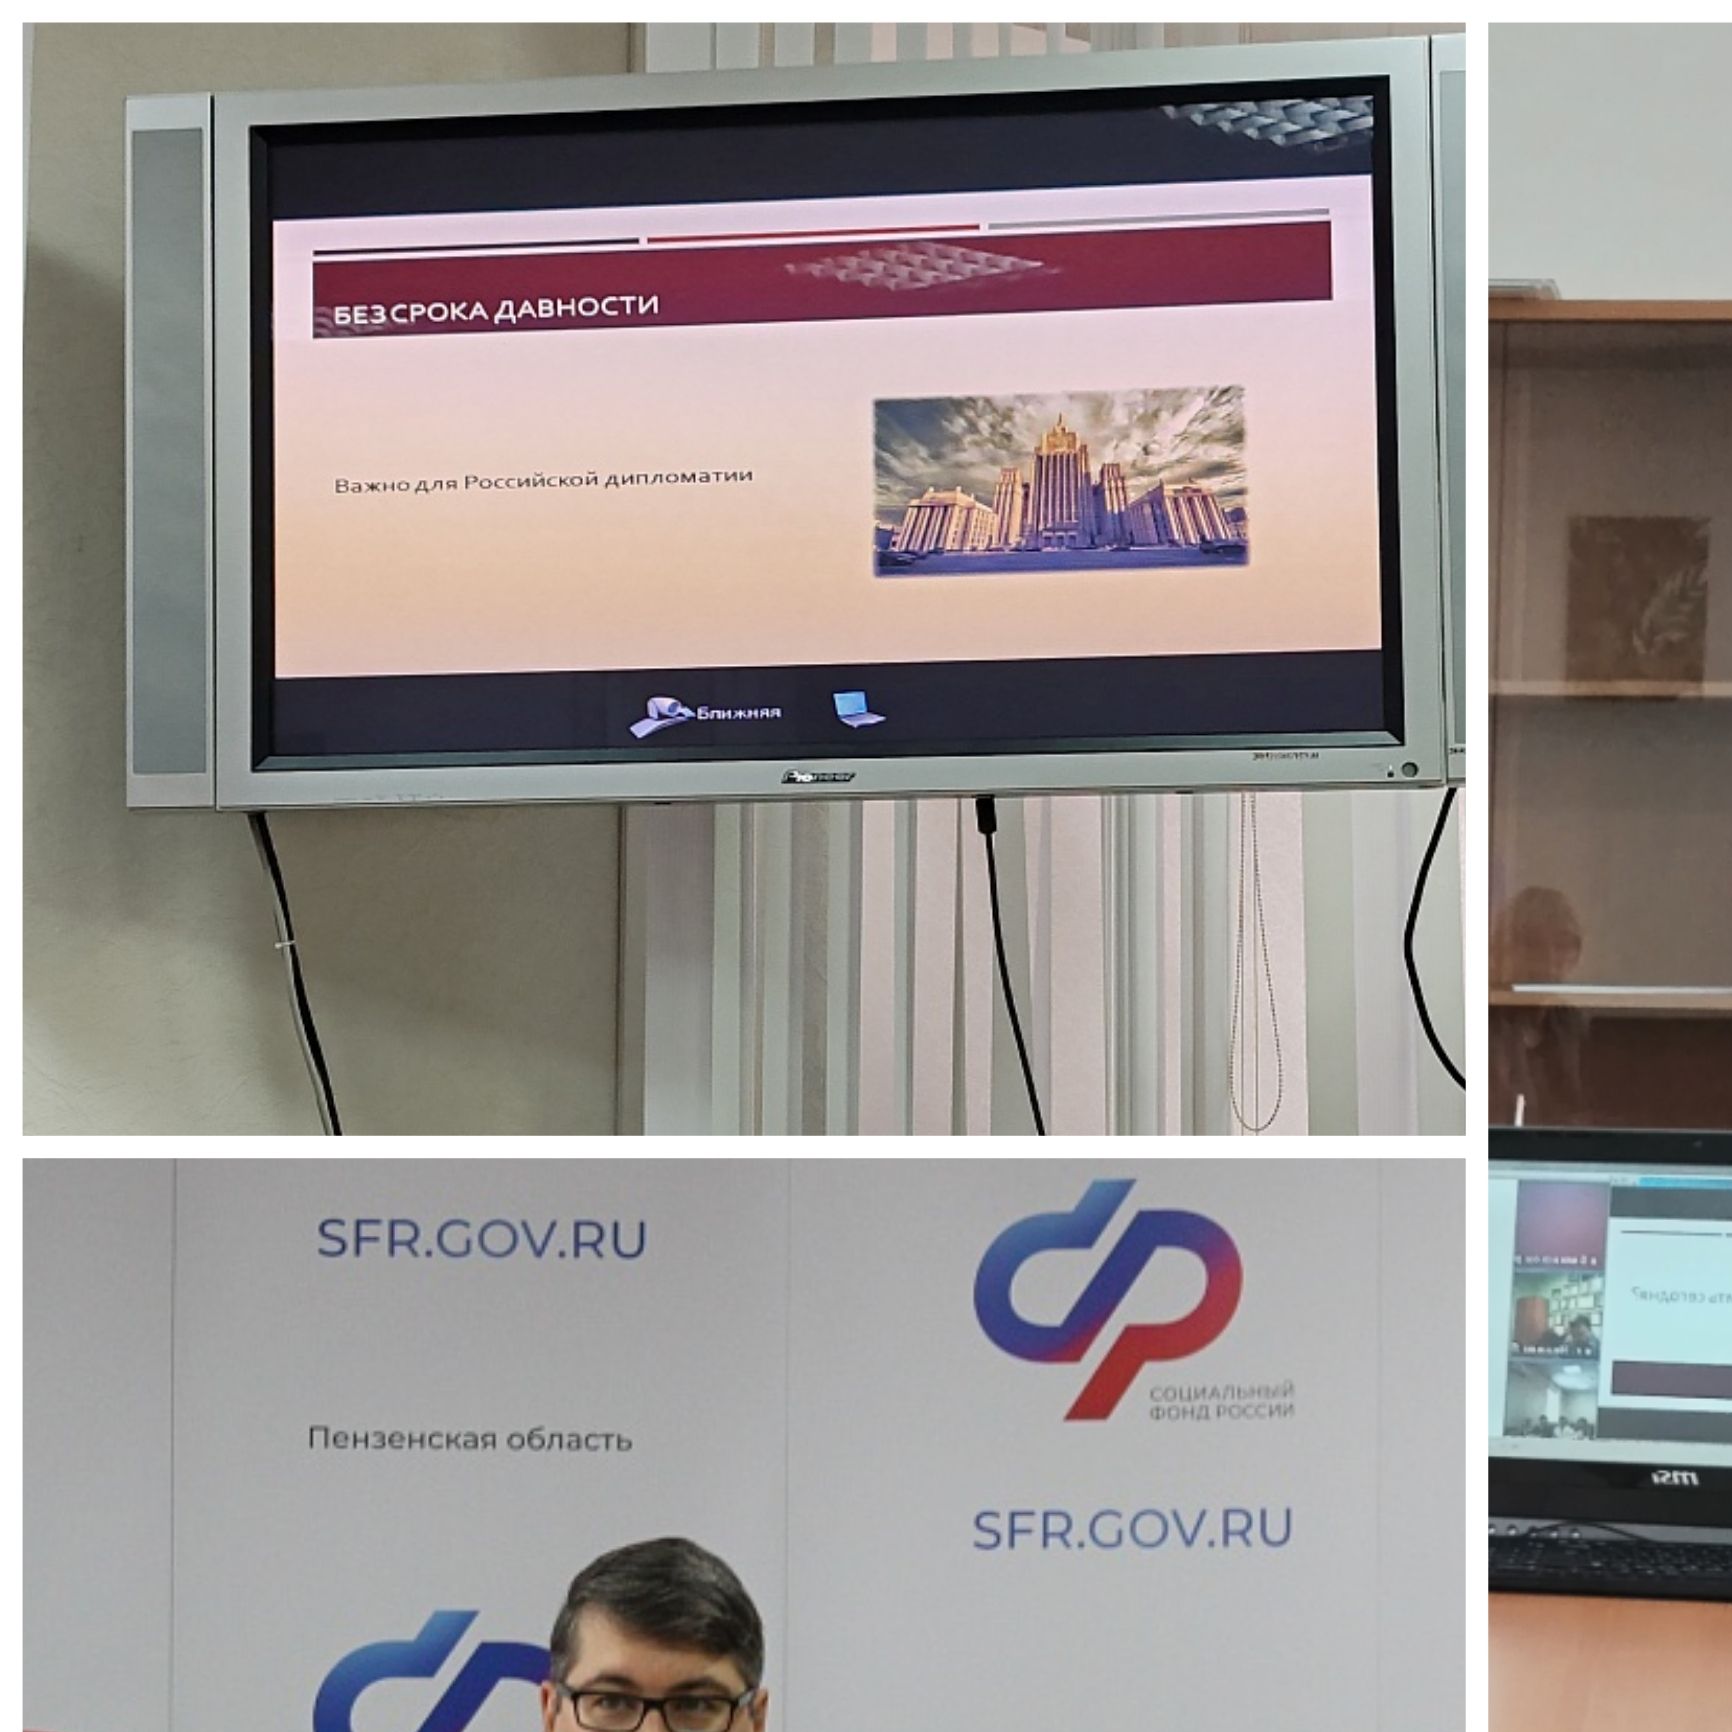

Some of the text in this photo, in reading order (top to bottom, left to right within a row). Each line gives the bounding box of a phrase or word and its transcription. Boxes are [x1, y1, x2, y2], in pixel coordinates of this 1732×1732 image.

[334, 295, 659, 325] БЕЗ СРОКА ДАВНОСТИ
[334, 468, 754, 494] Важно для Российской дипломатии
[696, 706, 782, 720] Ближняя
[317, 1218, 647, 1259] SFR.GOV.RU
[1149, 1380, 1295, 1402] СОЦИАЛЬНЫЙ
[1149, 1403, 1295, 1421] ФОНД РОССИИ
[308, 1425, 634, 1452] Пензенская область
[972, 1507, 1293, 1551] SFR.GOV.RU
